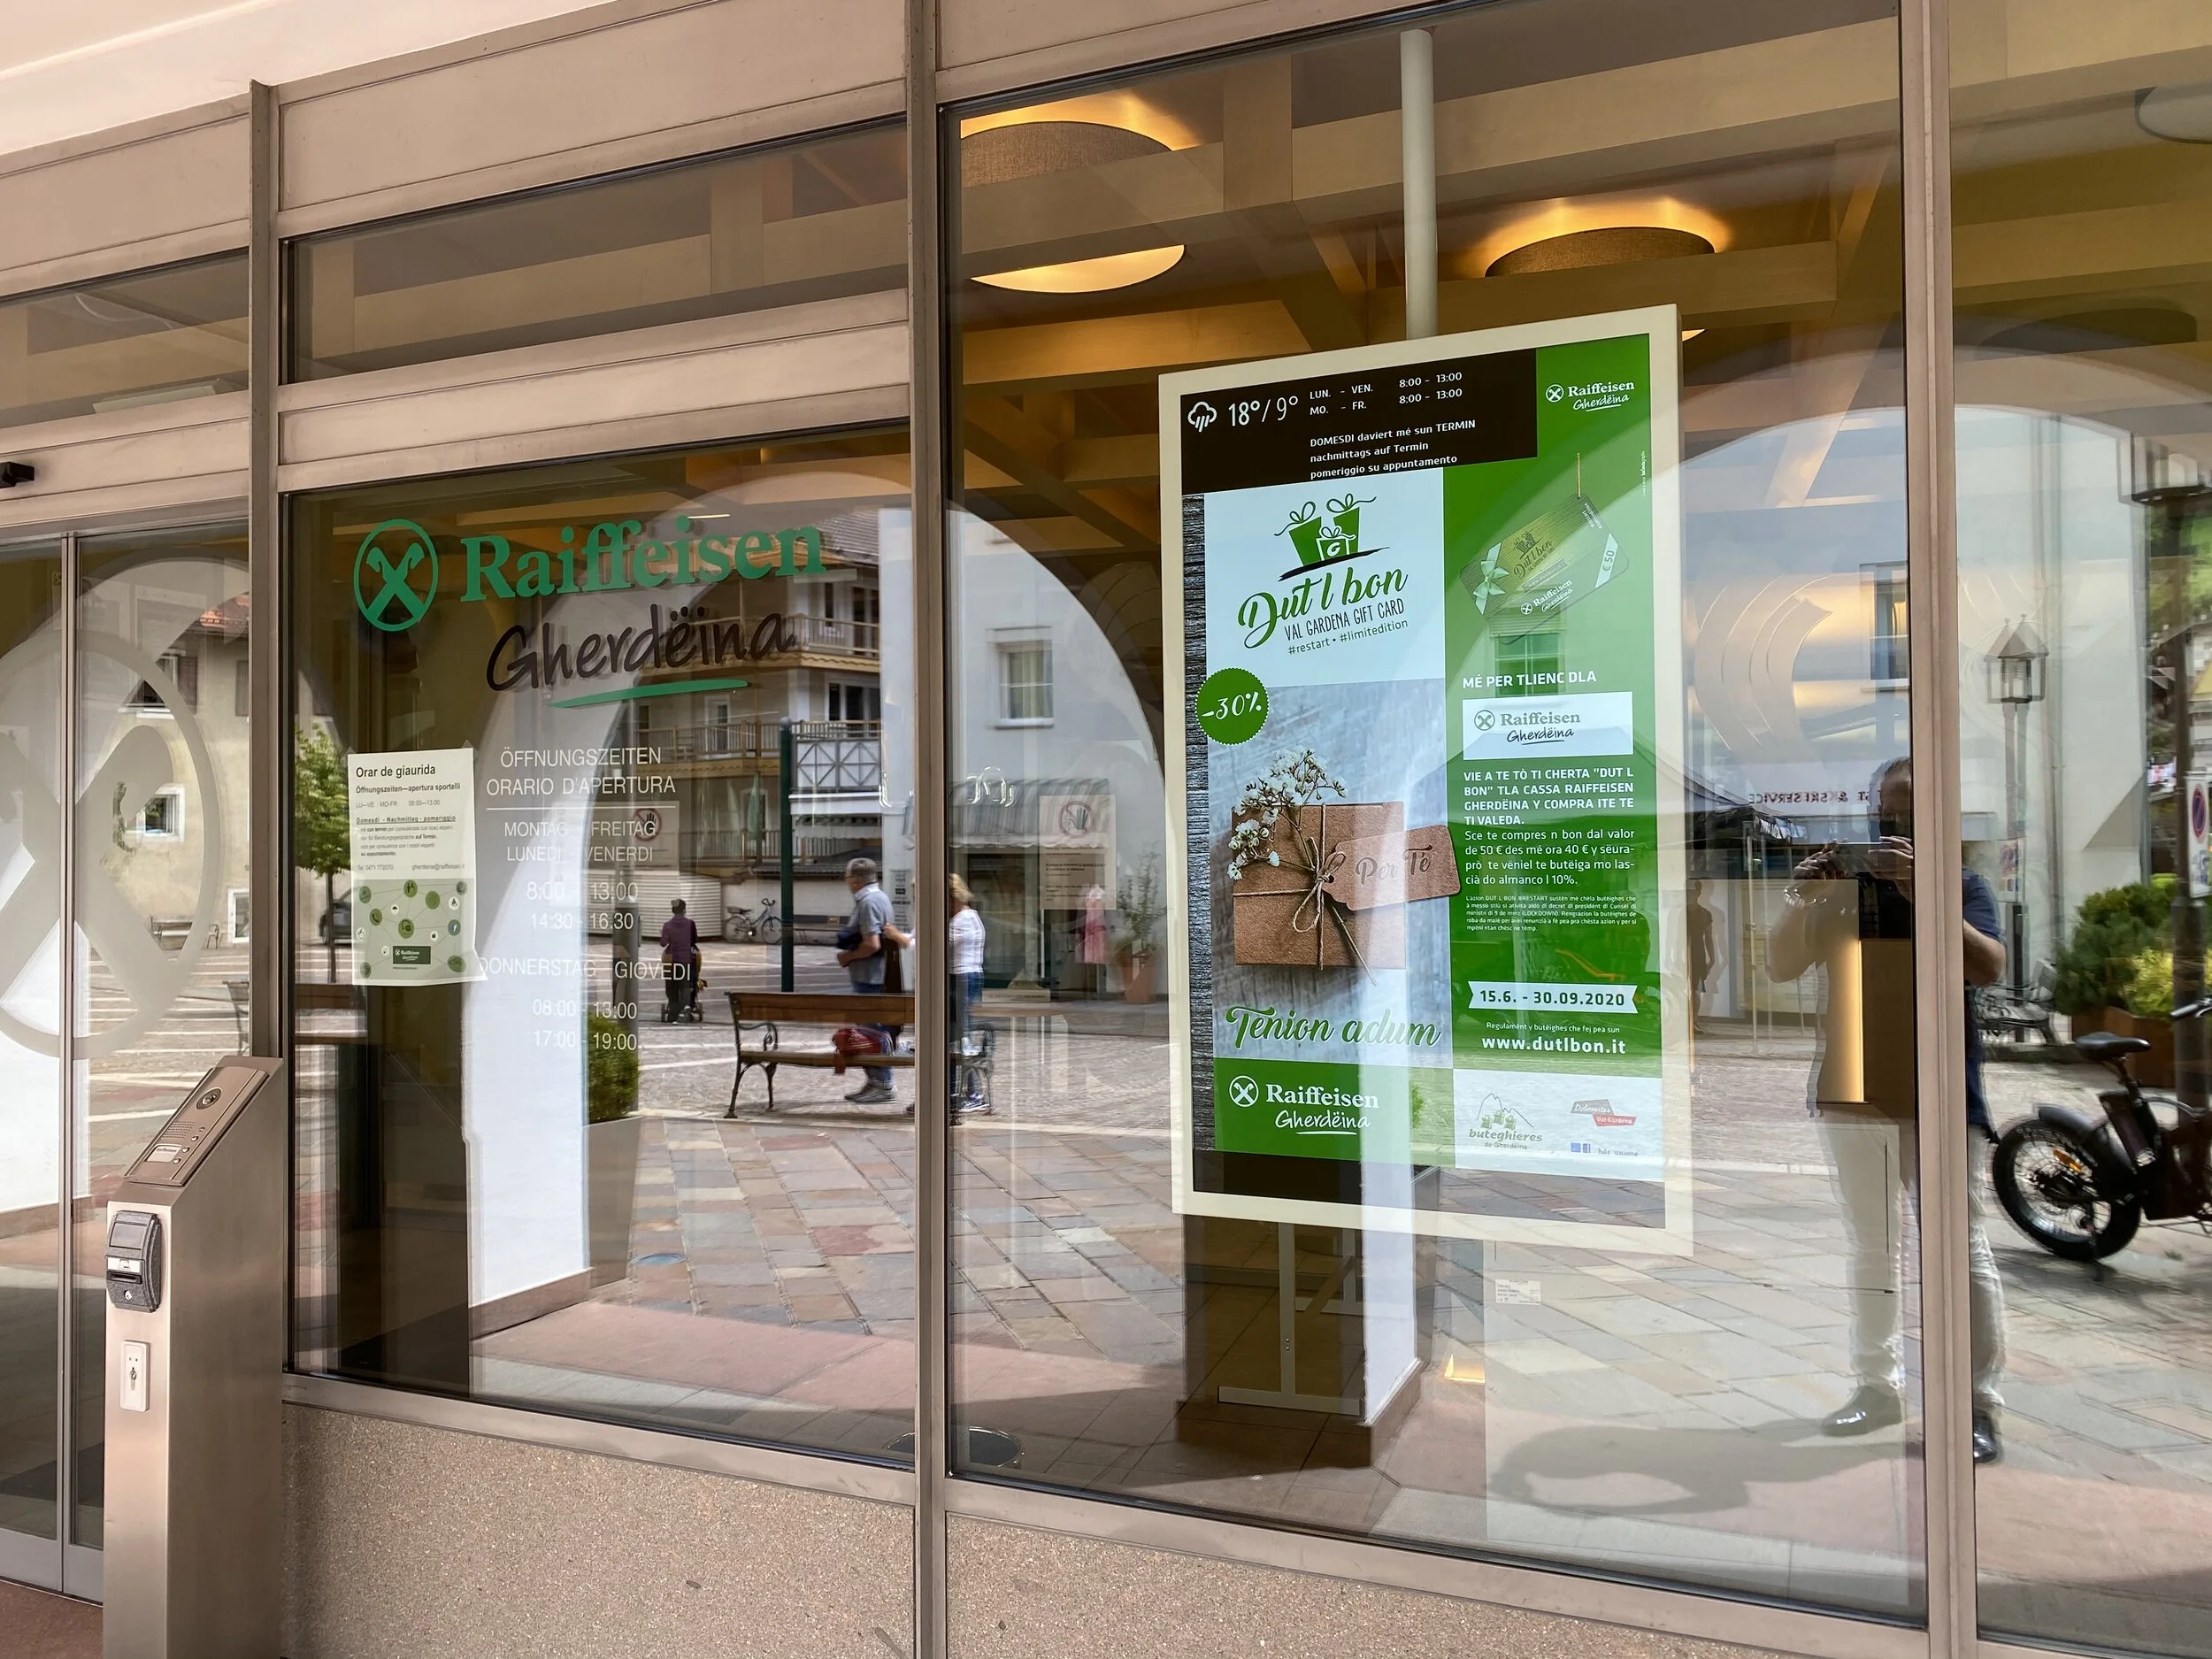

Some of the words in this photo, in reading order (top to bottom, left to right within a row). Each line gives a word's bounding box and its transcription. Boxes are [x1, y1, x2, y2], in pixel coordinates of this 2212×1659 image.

[1310, 389, 1331, 399] LUN.
[1351, 384, 1373, 394] VEN.
[1399, 377, 1422, 388] 8:00
[1436, 372, 1462, 383] 13:00
[1567, 380, 1634, 397] Raiffeisen
[1310, 406, 1329, 415] MO.
[1352, 401, 1367, 410] FR.
[1399, 394, 1422, 404] 8:00
[1436, 388, 1462, 399] 13:00
[1310, 434, 1354, 447] DOMESDI
[1357, 428, 1393, 442] daviert
[1415, 426, 1432, 434] sun
[1436, 419, 1476, 432] TERMIN
[1310, 448, 1371, 463] nachmittags
[1374, 446, 1391, 455] auf
[1394, 442, 1428, 453] Termin
[1310, 465, 1365, 480] pomeriggio
[1383, 455, 1457, 472] appuntamento
[460, 515, 826, 602] Raiffeisen
[1532, 580, 1571, 606] Raiffeisen
[1238, 578, 1322, 649] Dut
[1341, 567, 1408, 605] bon
[1284, 623, 1302, 641] VAL
[1306, 612, 1350, 636] GARDENA
[1353, 605, 1373, 625] GIFT
[1378, 598, 1404, 618] CARD
[1288, 637, 1330, 655] #restart
[1340, 619, 1408, 642] #limitedition
[1463, 674, 1482, 688] MÉ
[1486, 675, 1513, 687] PER
[1517, 672, 1564, 686] TLIENC
[1569, 671, 1596, 683] DLA
[1501, 712, 1580, 726] Raiffeisen
[501, 747, 662, 767] ÖFFNUNGSZEITEN
[356, 766, 378, 778] Orar
[380, 766, 393, 776] de
[396, 764, 435, 779] giaurida
[1463, 772, 1481, 781] VIE
[1485, 772, 1493, 780] A
[1496, 771, 1509, 780] TE
[1531, 770, 1541, 780] TI
[1545, 769, 1590, 779] CHERTA
[1627, 768, 1633, 777] L
[487, 778, 554, 795] ORARIO
[563, 776, 676, 795] D'APERTURA
[1497, 786, 1519, 795] TLA
[1524, 784, 1560, 795] CASSA
[1565, 783, 1633, 794] RAIFFEISEN
[1464, 799, 1529, 810] GHERDËINA
[1544, 799, 1594, 809] COMPRA
[1598, 799, 1615, 808] ITE
[1620, 798, 1633, 807] TE
[504, 821, 568, 837] MONTAG
[592, 821, 656, 836] FREITAG
[1464, 816, 1475, 825] TI
[1478, 815, 1524, 825] VALEDA.
[1465, 831, 1483, 841] Sce
[1502, 831, 1546, 842] compres
[1562, 829, 1582, 839] bon
[1587, 829, 1602, 839] dal
[1608, 829, 1634, 838] valor
[507, 847, 560, 862] LUNEDI
[588, 846, 653, 862] VENERDI
[1465, 846, 1478, 855] de
[1480, 845, 1493, 855] 50
[1496, 845, 1503, 855] €
[1505, 845, 1524, 855] des
[1564, 844, 1578, 854] 40
[1582, 844, 1588, 854] €
[1591, 846, 1596, 856] y
[1483, 875, 1495, 884] do
[1499, 875, 1543, 884] almanco
[1552, 875, 1578, 884] 10%.
[526, 882, 565, 900] 8:00
[592, 882, 638, 900] 13:00
[531, 913, 572, 929] 14:30
[616, 961, 691, 981] GIOVEDI
[1480, 990, 1517, 1002] 15.6.
[1533, 992, 1624, 1006] 30.09.2020
[534, 999, 574, 1017] 08:00
[593, 1002, 637, 1019] 13:00
[1225, 1005, 1335, 1049] Tenion
[1341, 1009, 1442, 1048] adum
[534, 1030, 575, 1048] 17:00
[593, 1033, 637, 1051] 19:00
[1482, 1036, 1625, 1054] www.dutlbon.it
[1265, 1083, 1379, 1109] Raiffeisen
[1469, 1128, 1543, 1142] buteghieres
